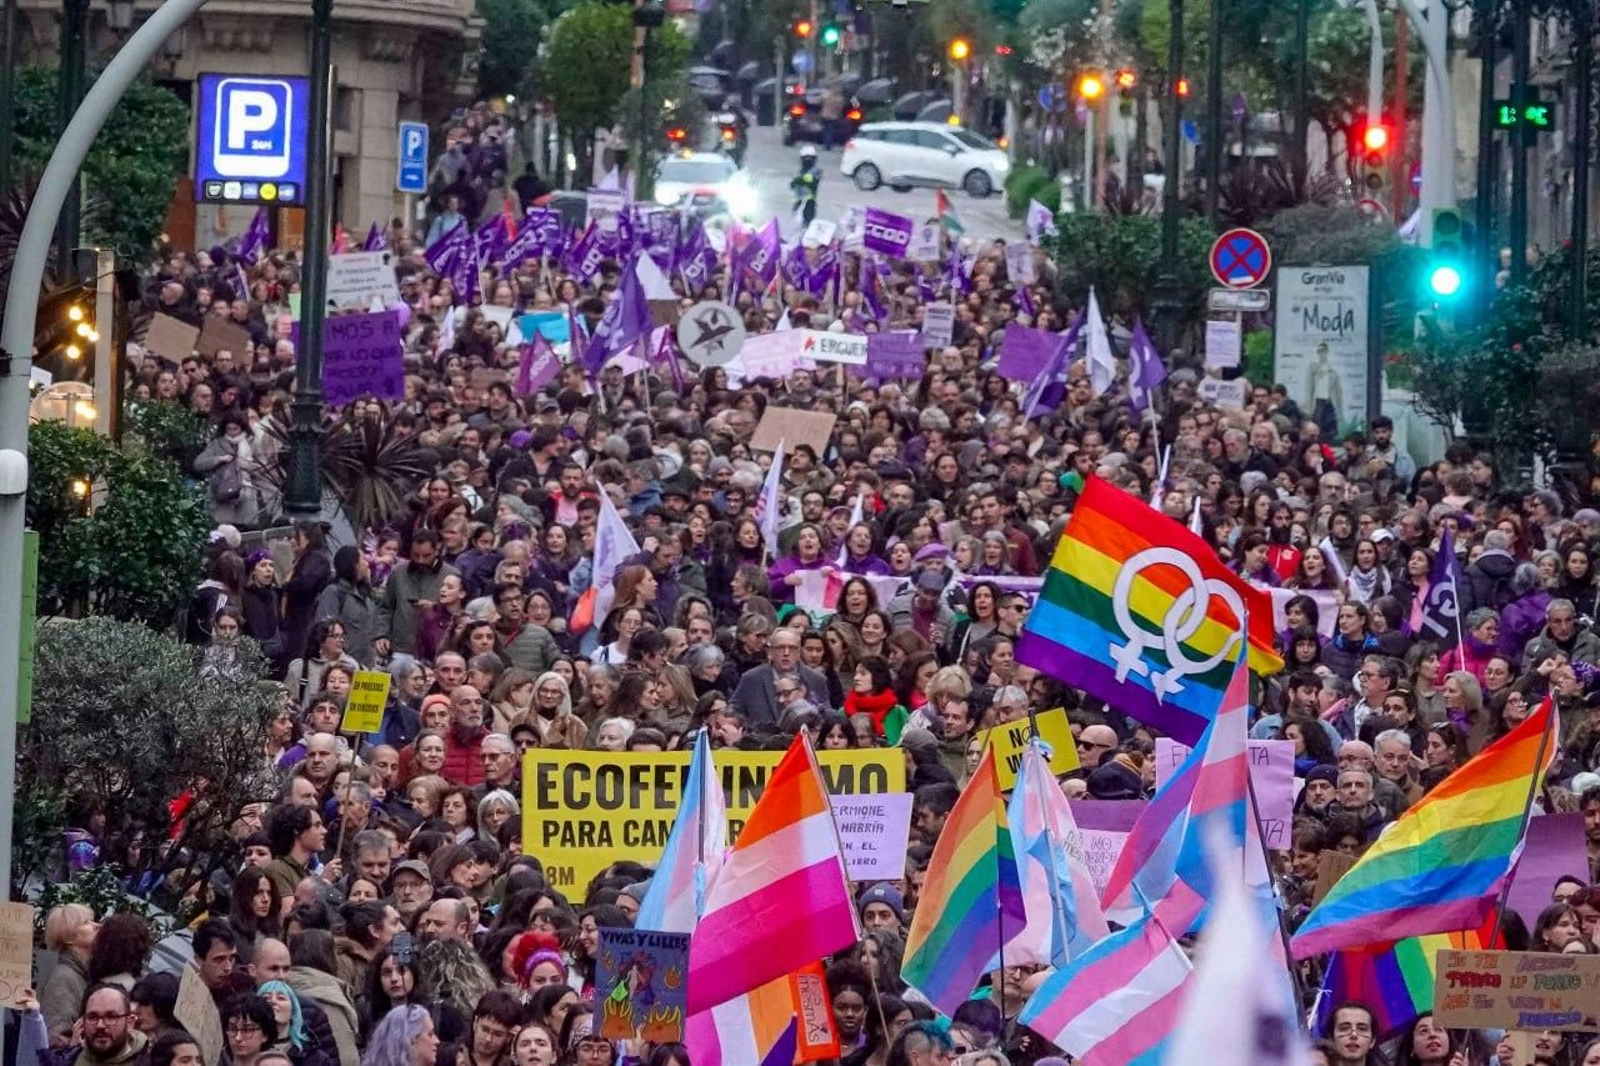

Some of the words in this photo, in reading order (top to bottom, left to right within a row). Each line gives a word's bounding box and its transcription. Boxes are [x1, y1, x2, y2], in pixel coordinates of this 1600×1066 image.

[228, 89, 277, 149] P
[407, 131, 422, 157] P
[1303, 303, 1354, 336] Moda
[537, 762, 887, 811] ECOFEINMO
[543, 820, 613, 848] PARA
[546, 866, 575, 886] 8M
[601, 931, 635, 945] VIVAS
[636, 933, 648, 947] Y
